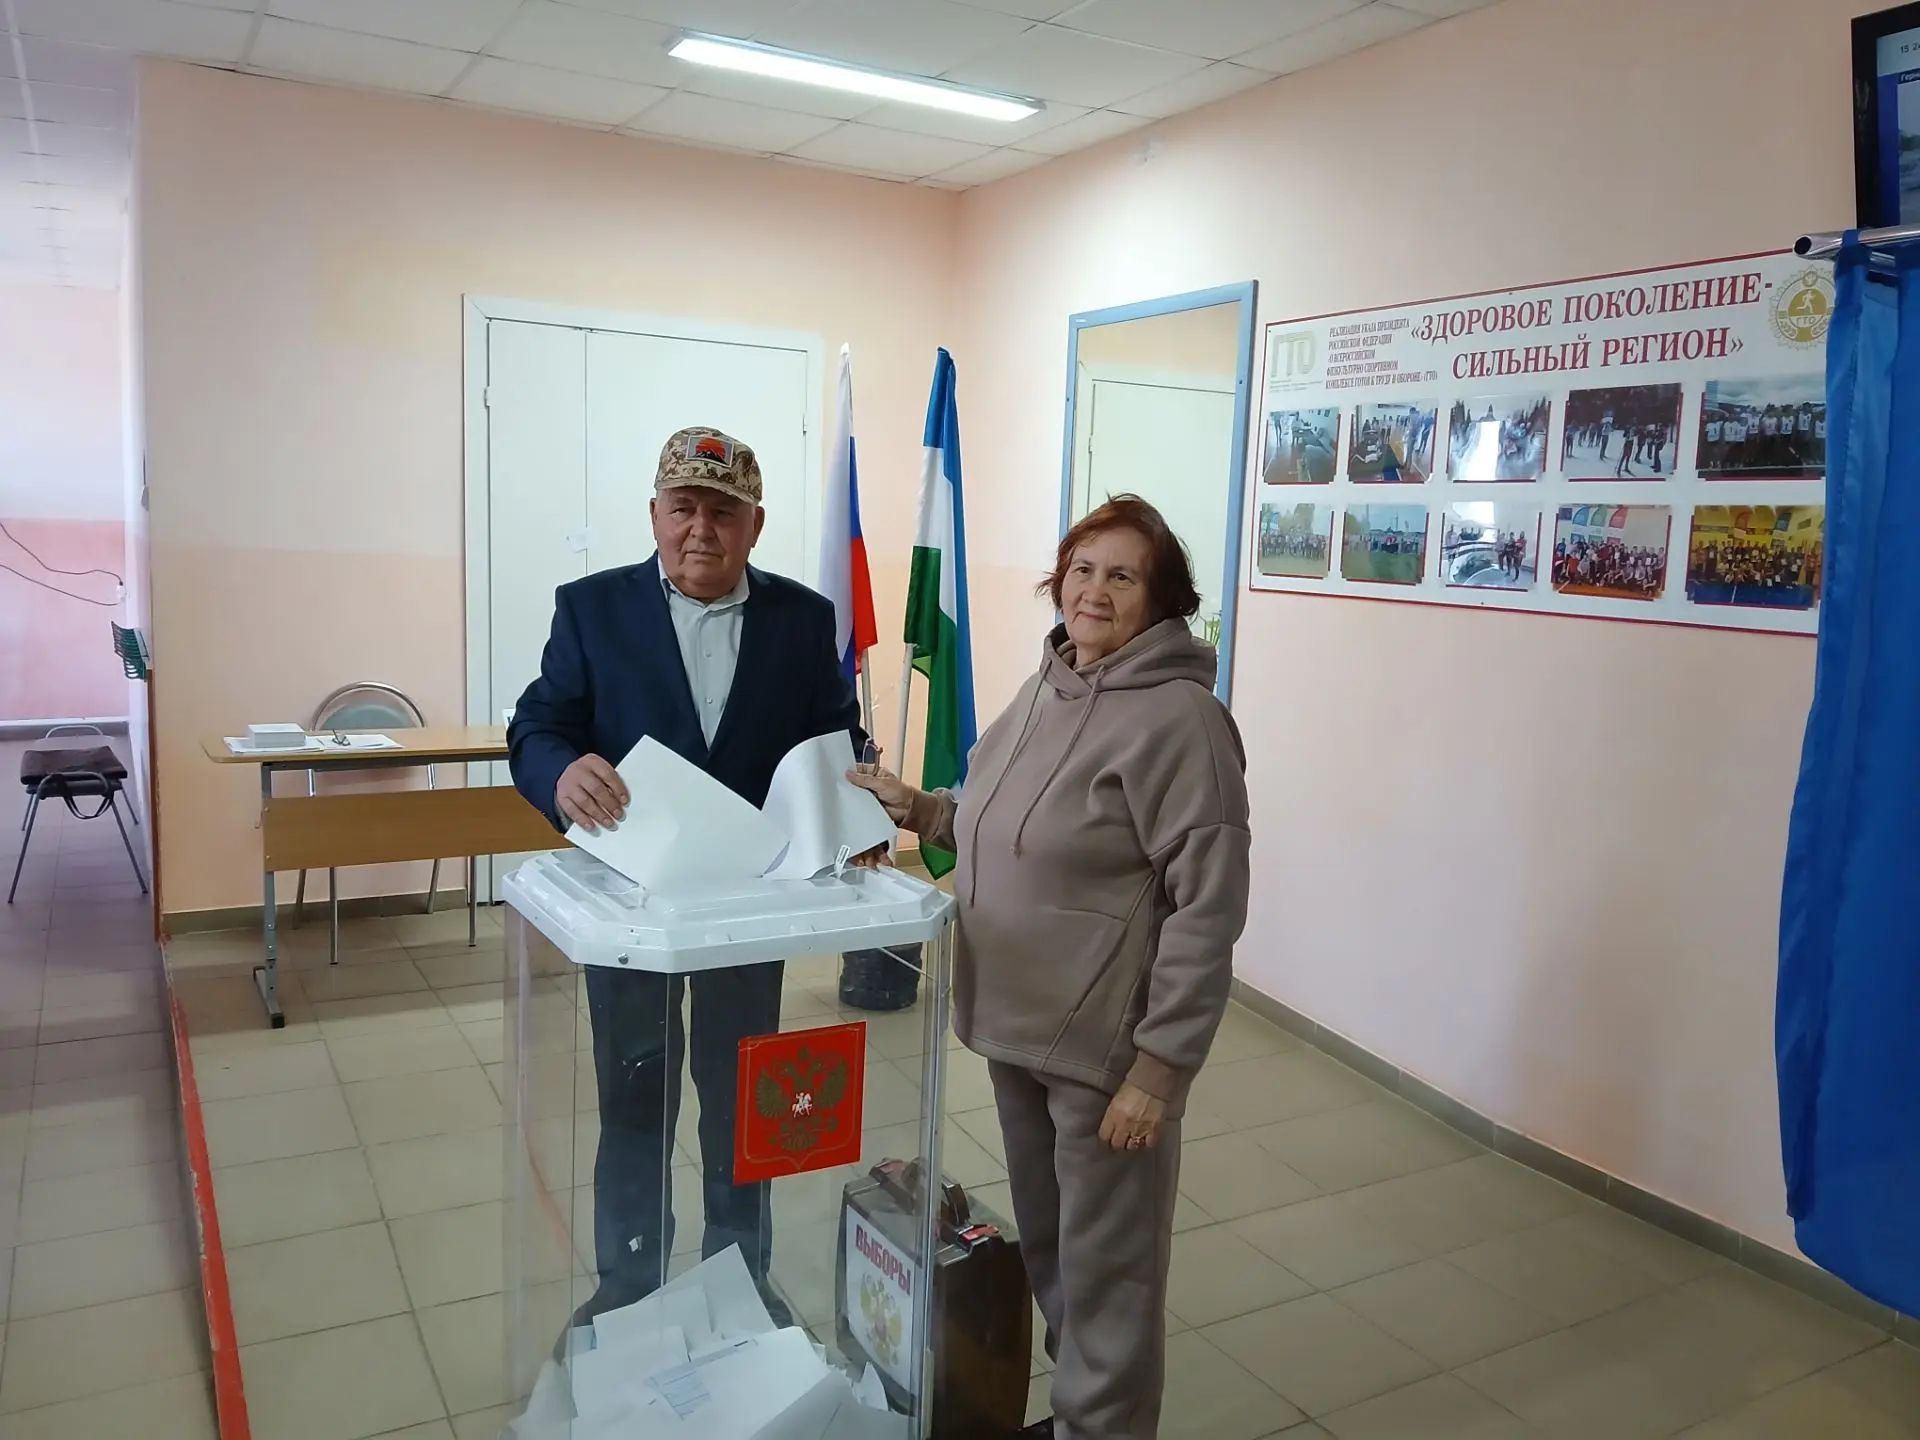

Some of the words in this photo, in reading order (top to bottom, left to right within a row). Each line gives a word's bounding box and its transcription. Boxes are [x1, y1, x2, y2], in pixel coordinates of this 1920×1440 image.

[1411, 299, 1552, 346] «ЗДОРОВОЕ
[1562, 272, 1772, 324] ПОКОЛЕНИЕ-
[1797, 316, 1816, 325] ГТО
[1270, 331, 1316, 378] ГТО
[1453, 333, 1591, 379] СИЛЬНЫЙ
[1601, 327, 1743, 367] РЕГИОН»
[856, 1223, 911, 1296] ВЫБОРЫ
